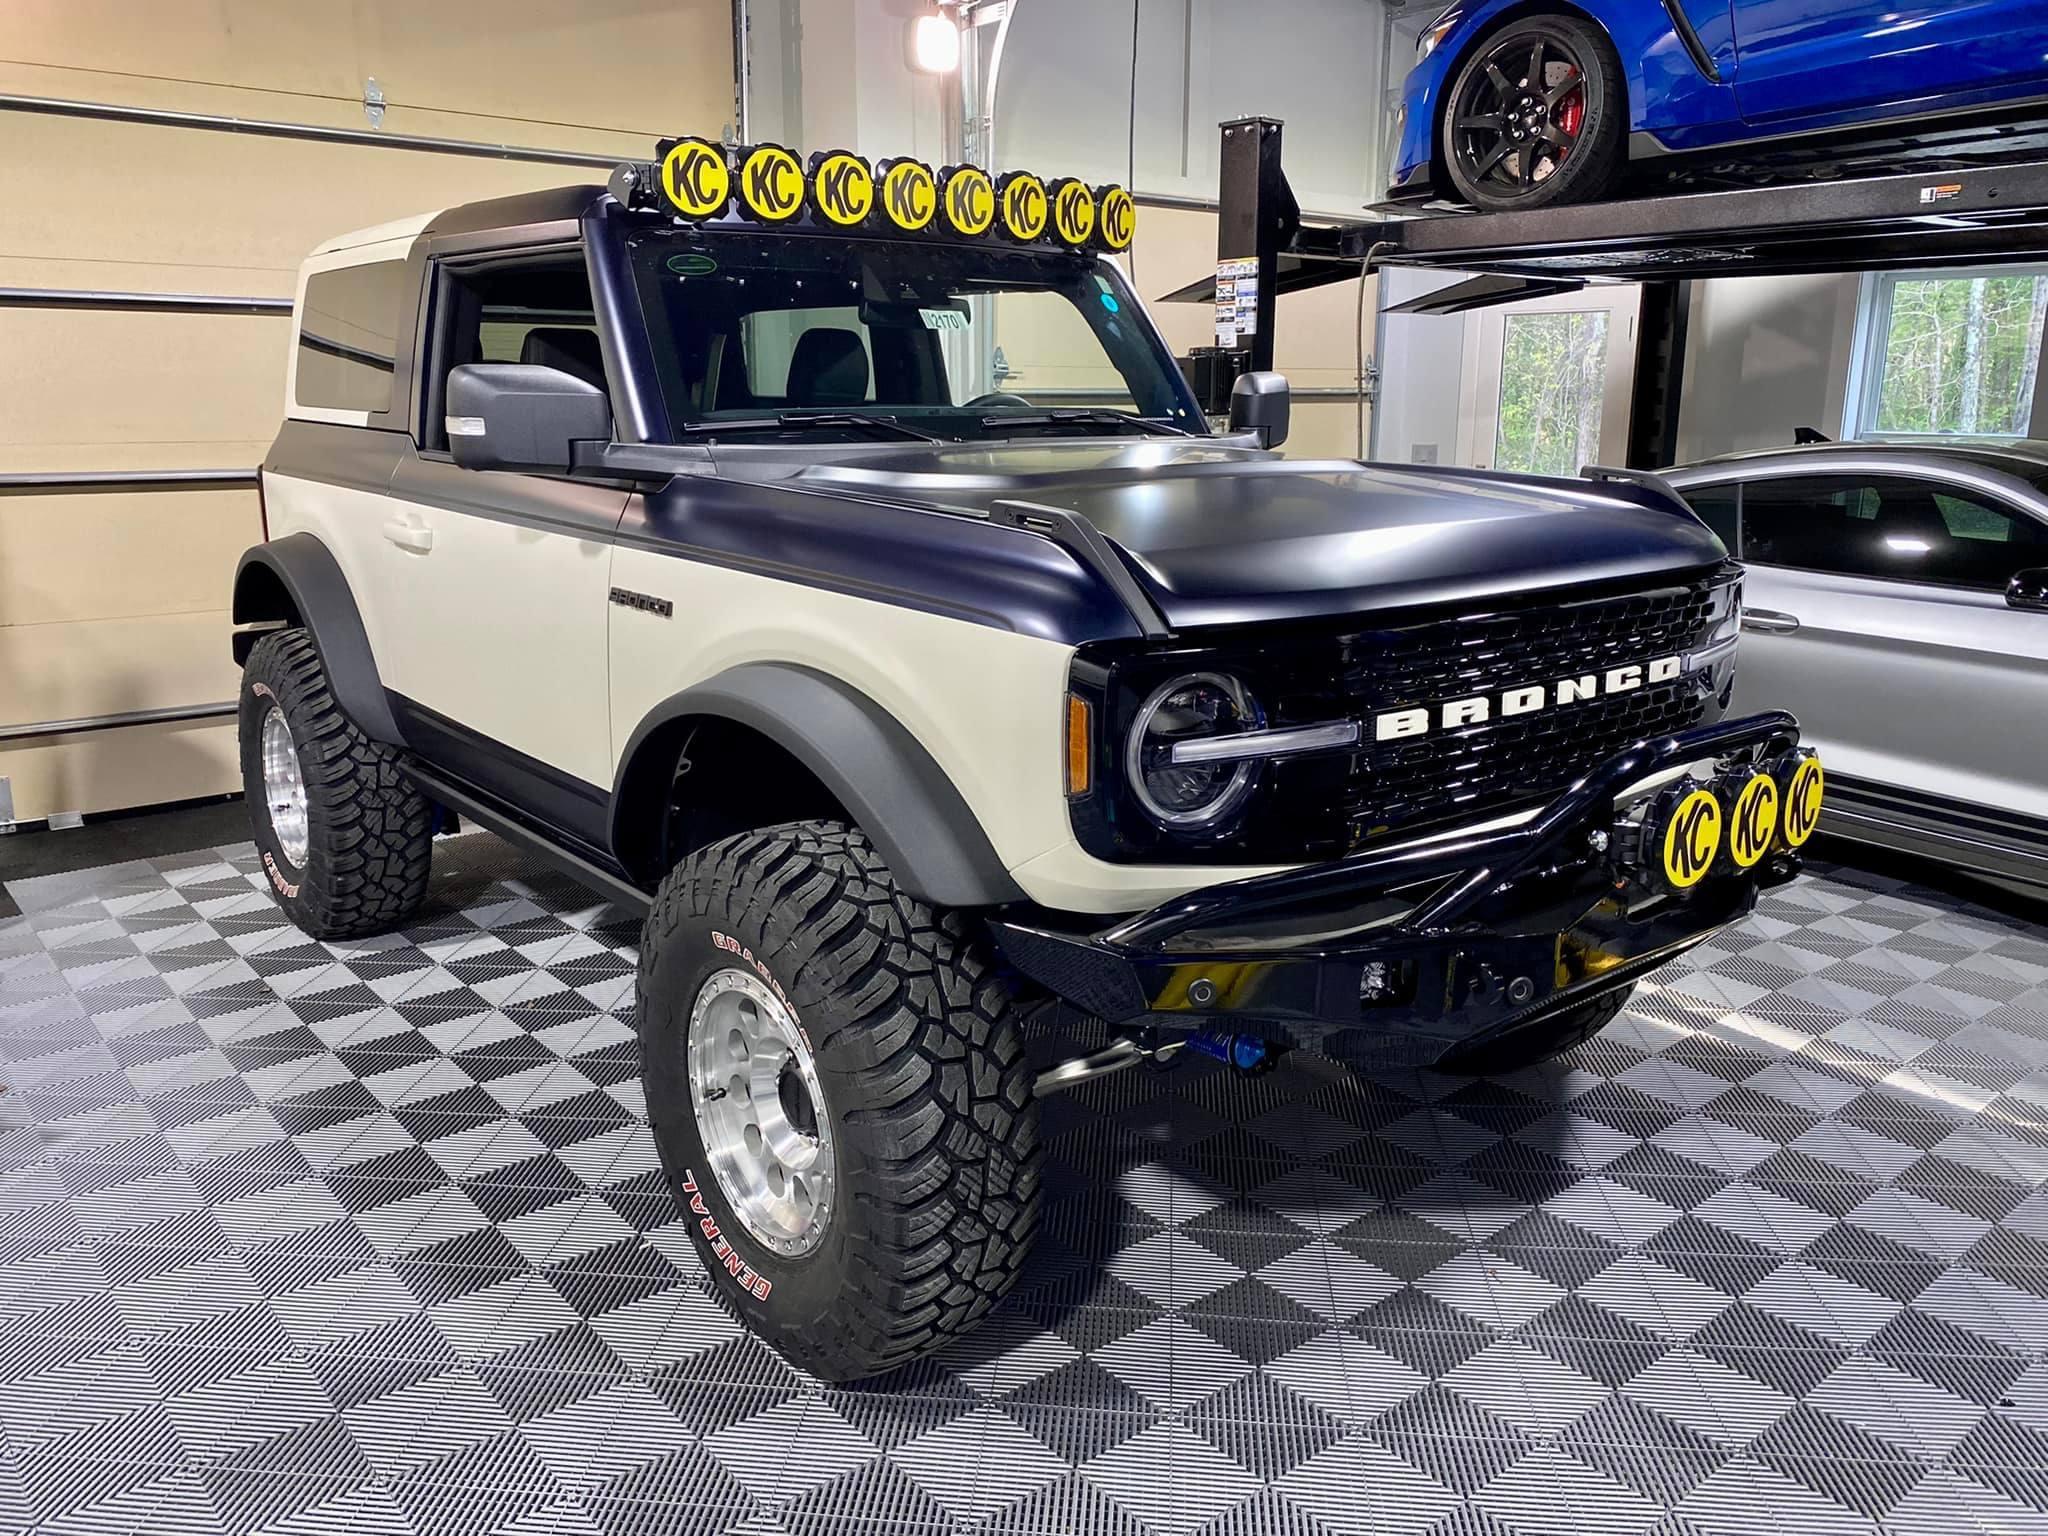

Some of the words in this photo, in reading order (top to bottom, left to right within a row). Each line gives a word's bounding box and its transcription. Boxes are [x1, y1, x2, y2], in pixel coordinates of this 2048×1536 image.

[672, 149, 719, 208] KC
[751, 155, 795, 212] KC
[824, 161, 865, 218] KC
[892, 169, 928, 223] KC
[953, 175, 987, 228] KC
[1010, 182, 1040, 234] KC
[1061, 188, 1088, 237] KC
[1107, 194, 1131, 242] KC
[609, 586, 674, 618] BRONCO
[1375, 655, 1681, 741] BRONCO
[1736, 782, 1773, 859] KC
[1790, 764, 1819, 838] KC
[1671, 799, 1714, 879] KC
[682, 1169, 773, 1301] GENERAL
